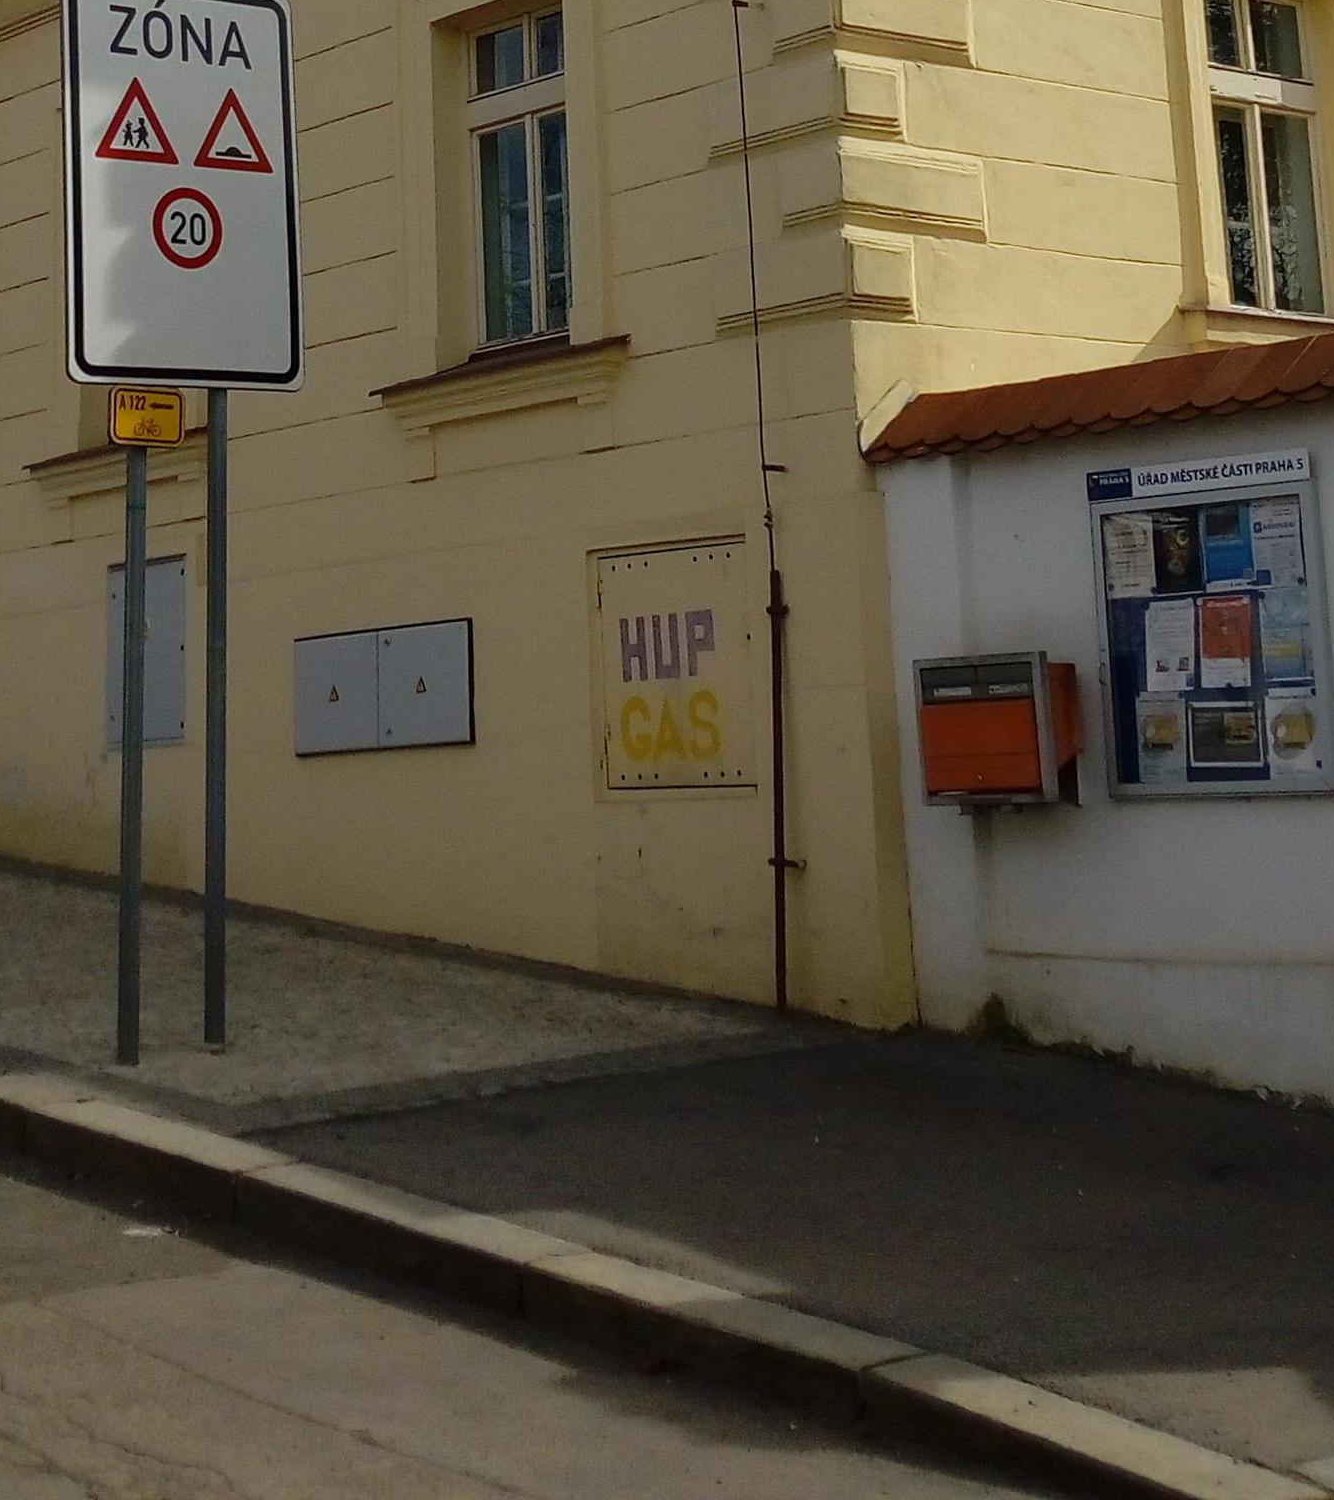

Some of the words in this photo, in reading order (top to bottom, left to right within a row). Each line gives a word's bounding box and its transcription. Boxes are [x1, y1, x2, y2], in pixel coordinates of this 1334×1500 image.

[109, 0, 252, 70] ZÓNA
[170, 211, 207, 247] 20
[119, 396, 127, 411] A
[129, 395, 147, 411] 122
[1170, 465, 1219, 484] MĚSTSKÉ
[1221, 462, 1253, 478] ČÁSTI
[1255, 459, 1294, 474] PRAHA
[1296, 458, 1304, 470] 5
[619, 609, 716, 682] HUP
